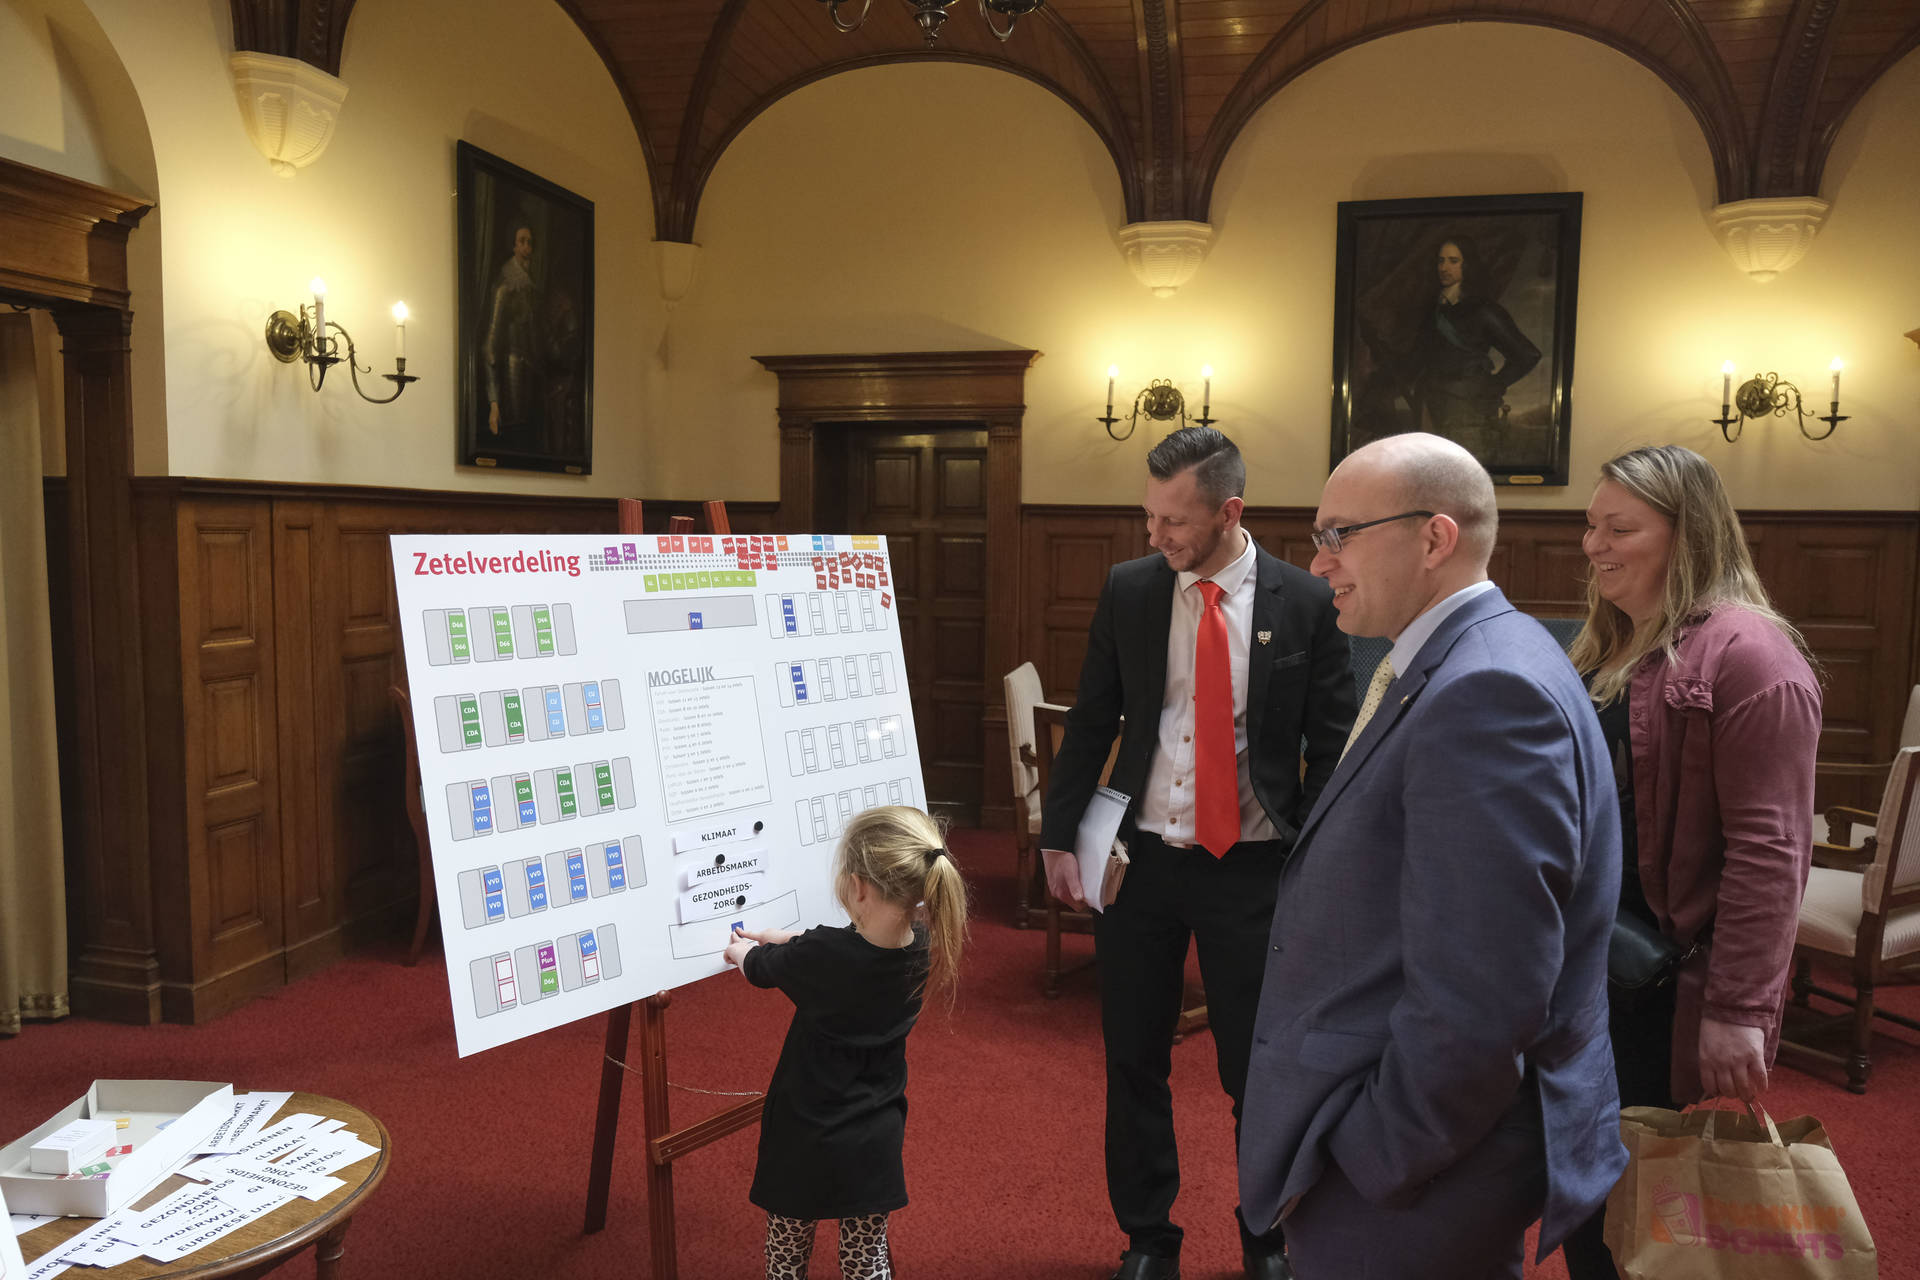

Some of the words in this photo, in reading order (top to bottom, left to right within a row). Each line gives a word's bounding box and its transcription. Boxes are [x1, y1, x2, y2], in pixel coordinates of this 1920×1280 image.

[413, 550, 581, 577] Zetelverdeling
[648, 666, 715, 687] MOGELIJK
[519, 787, 530, 795] CDA
[475, 794, 488, 802] VVD
[476, 815, 489, 823] VVD
[701, 828, 737, 842] KLIMAAT
[608, 851, 619, 859] VVD
[570, 862, 581, 871] VVD
[696, 858, 758, 879] ARBEIDSMARKT
[529, 870, 542, 879] VVD
[611, 873, 622, 881] VVD
[487, 877, 500, 886] VVD
[532, 893, 544, 901] VVD
[692, 882, 753, 903] GEZONDHEIDS-
[488, 901, 501, 909] VVD
[713, 898, 735, 910] ZORG
[583, 940, 594, 949] VVD
[262, 1166, 295, 1178] ZORG
[177, 1213, 250, 1252] EUROPESE
[1705, 1223, 1844, 1260] DONUTS
